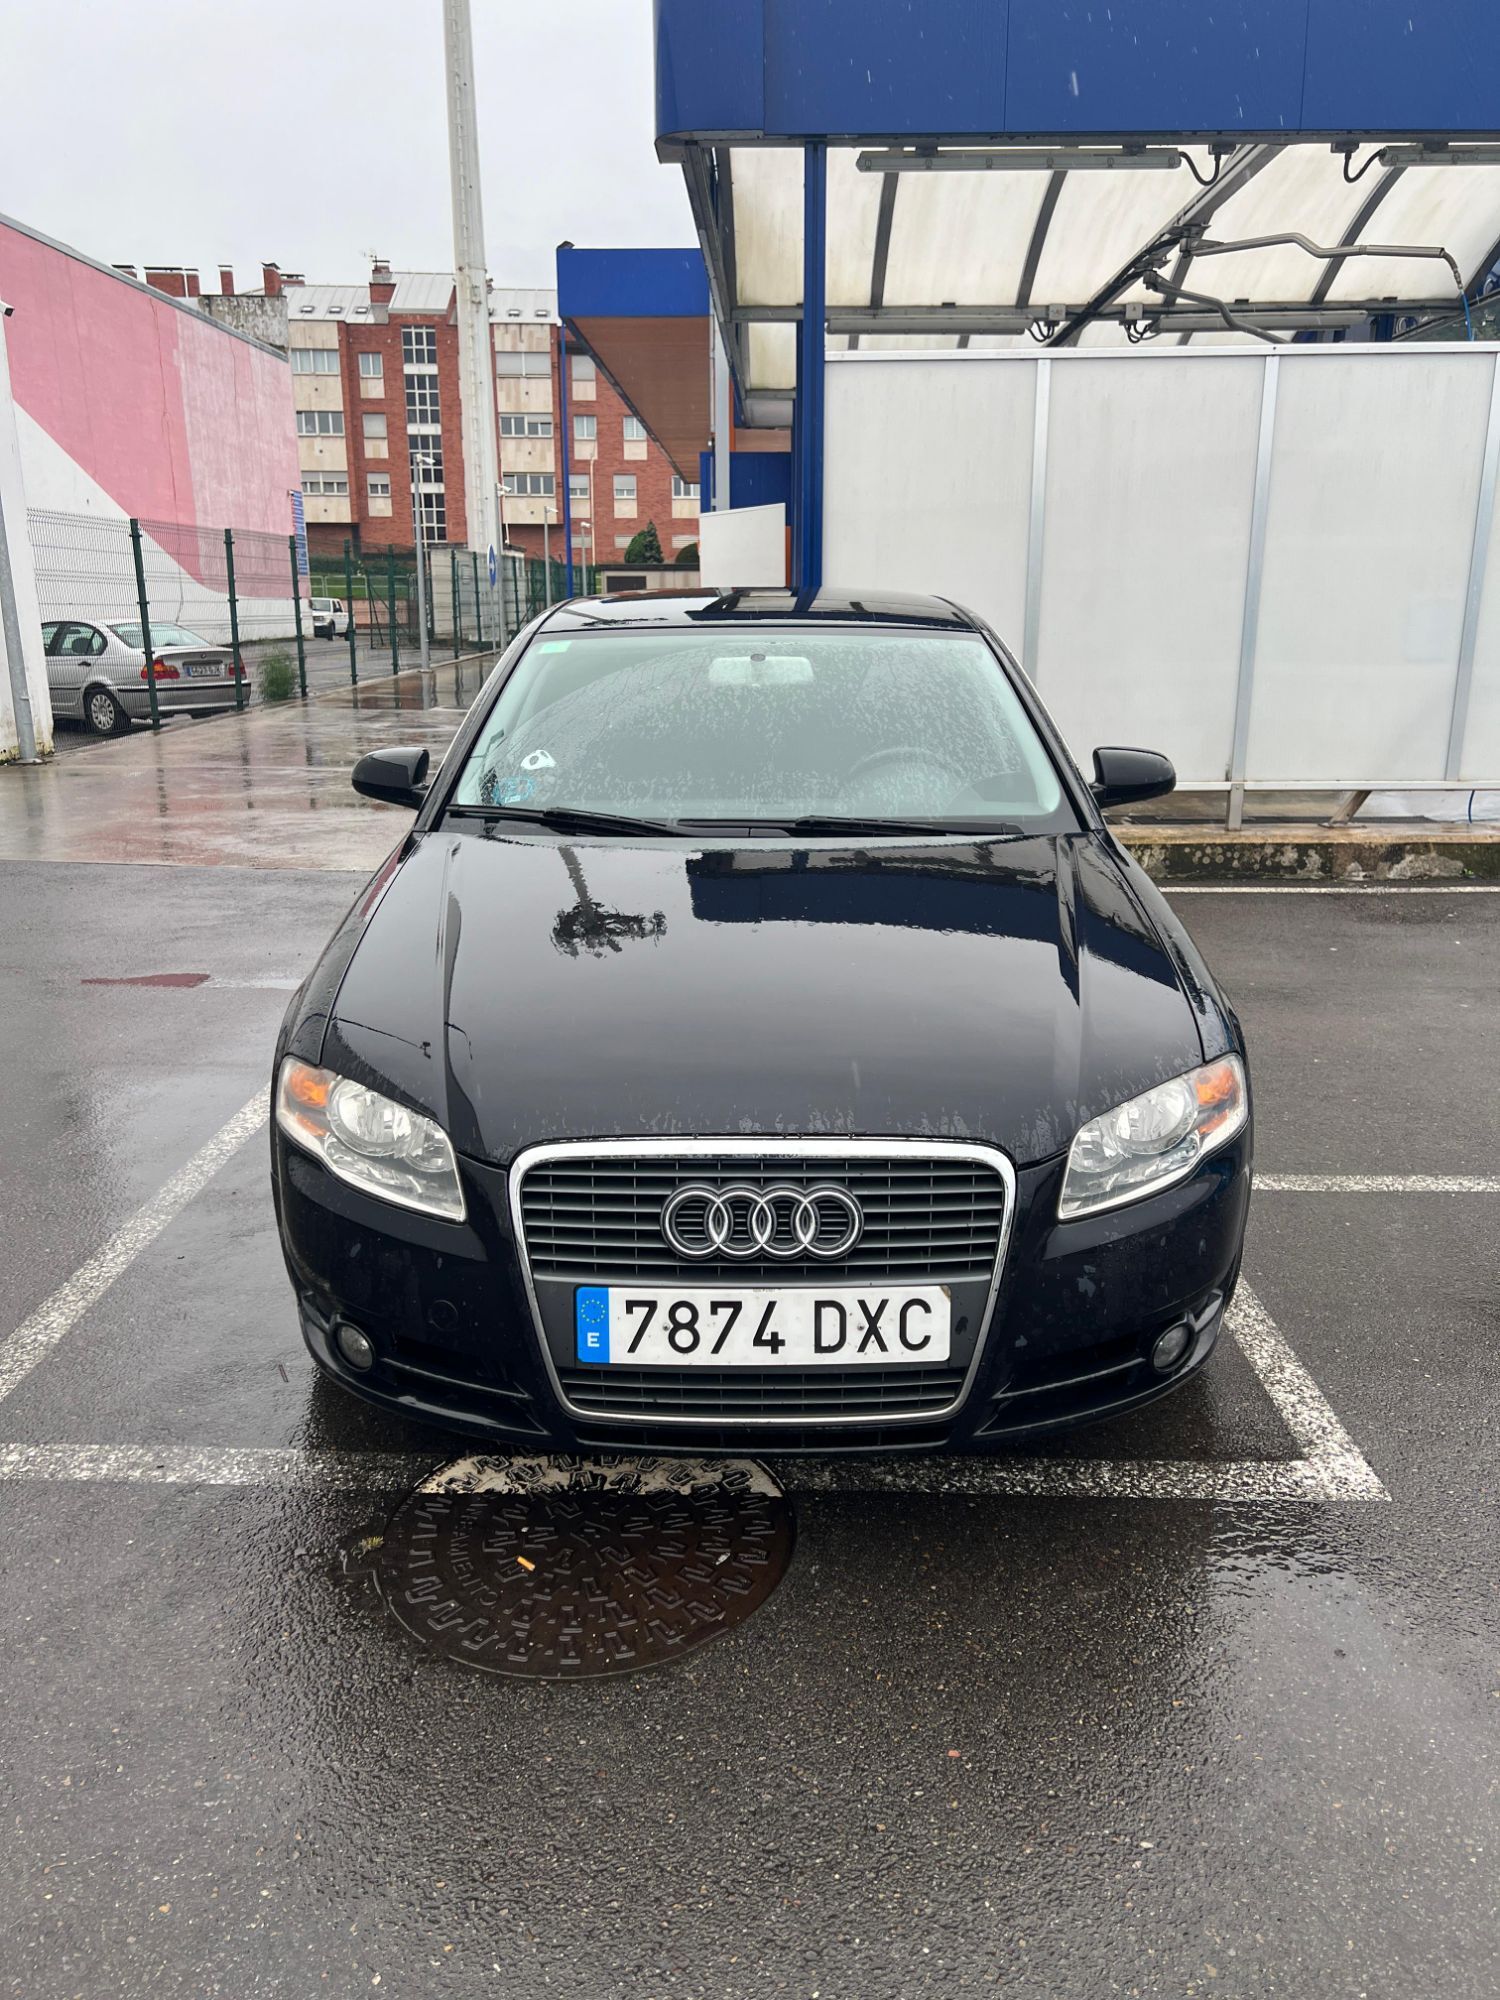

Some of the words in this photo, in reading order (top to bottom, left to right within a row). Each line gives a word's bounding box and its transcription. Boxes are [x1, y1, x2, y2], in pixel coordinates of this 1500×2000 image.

[586, 1332, 600, 1347] E
[624, 1299, 786, 1355] 7874
[813, 1298, 933, 1354] DXC
[450, 1492, 499, 1607] NEAMIENTO
